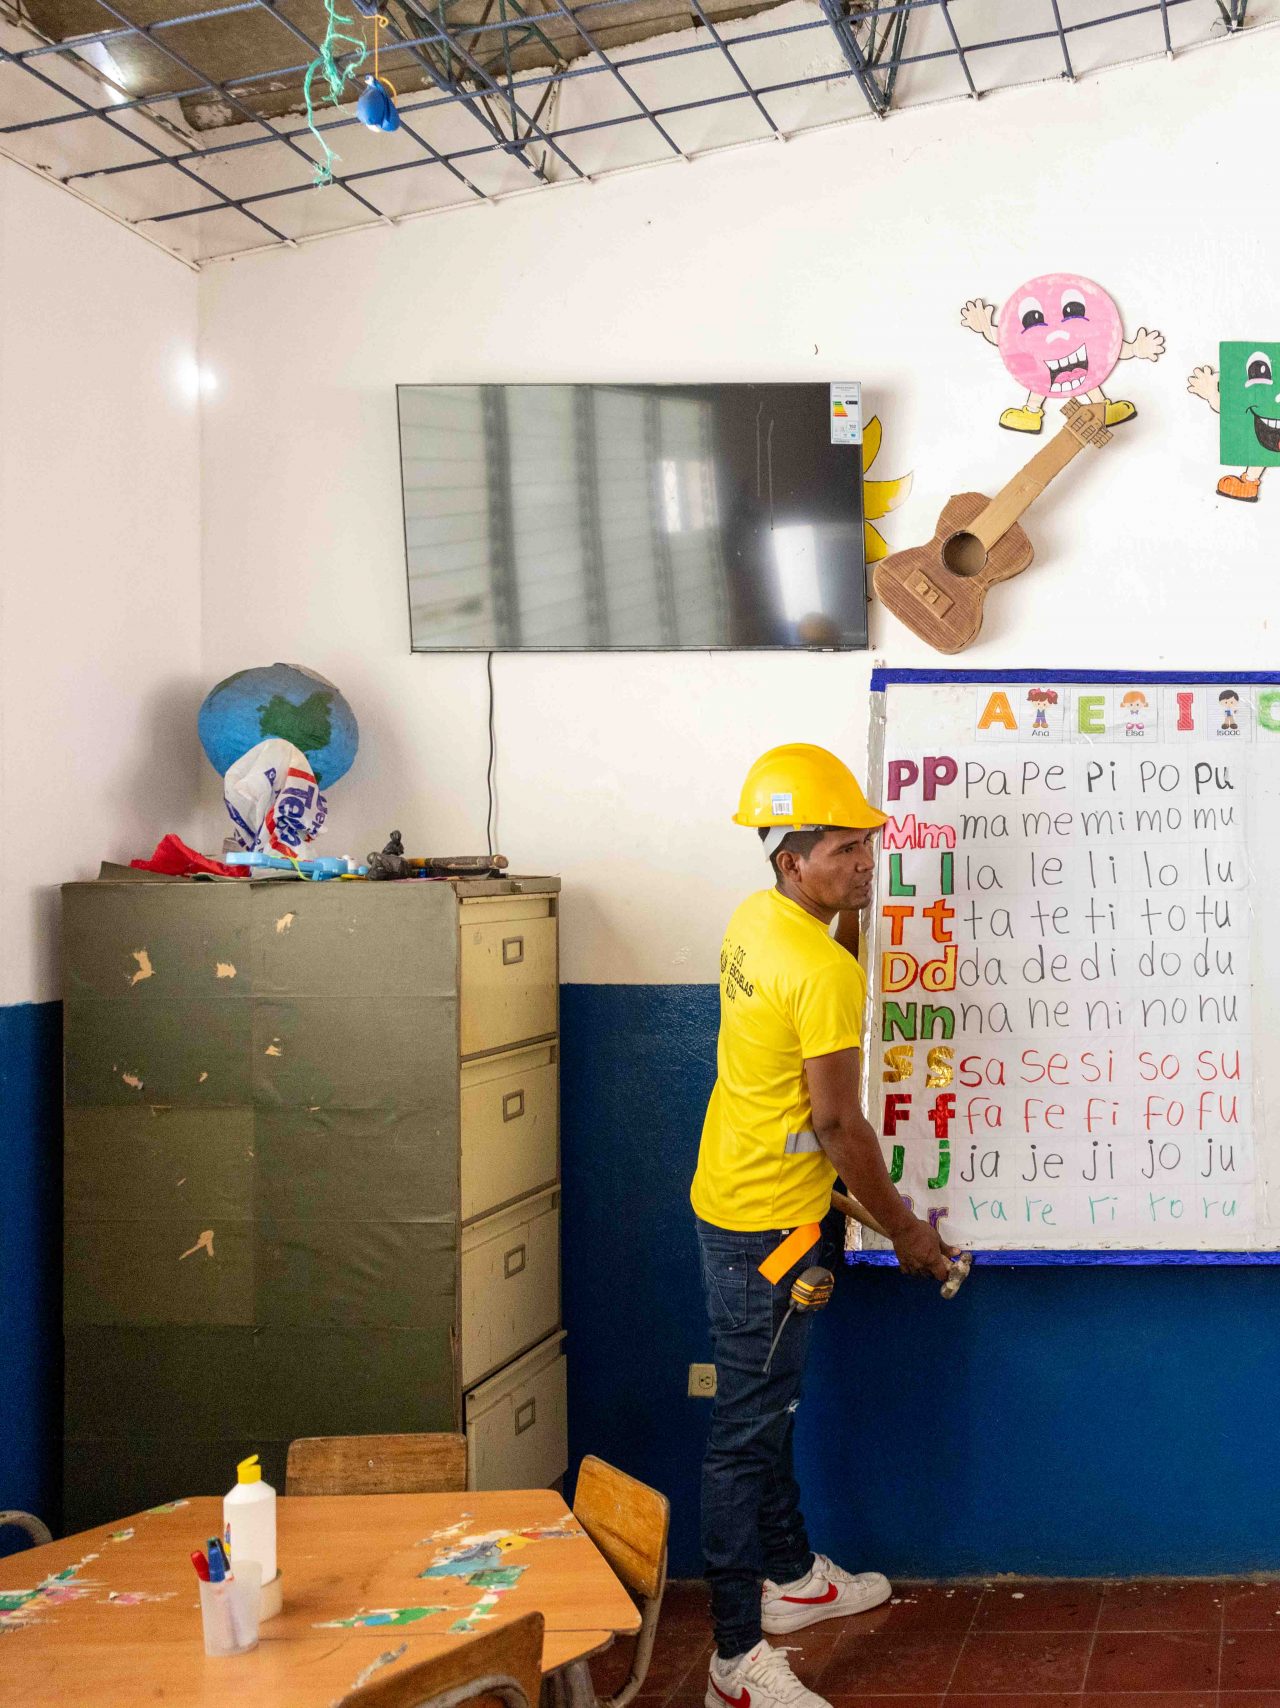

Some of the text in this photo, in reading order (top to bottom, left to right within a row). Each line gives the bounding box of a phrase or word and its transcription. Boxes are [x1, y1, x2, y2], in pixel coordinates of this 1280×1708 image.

[977, 691, 1018, 730] A
[1078, 695, 1106, 734] E
[1176, 692, 1194, 731] I
[1031, 729, 1050, 737] Ana
[1125, 729, 1145, 737] Elsa
[1216, 729, 1240, 737] Isaac
